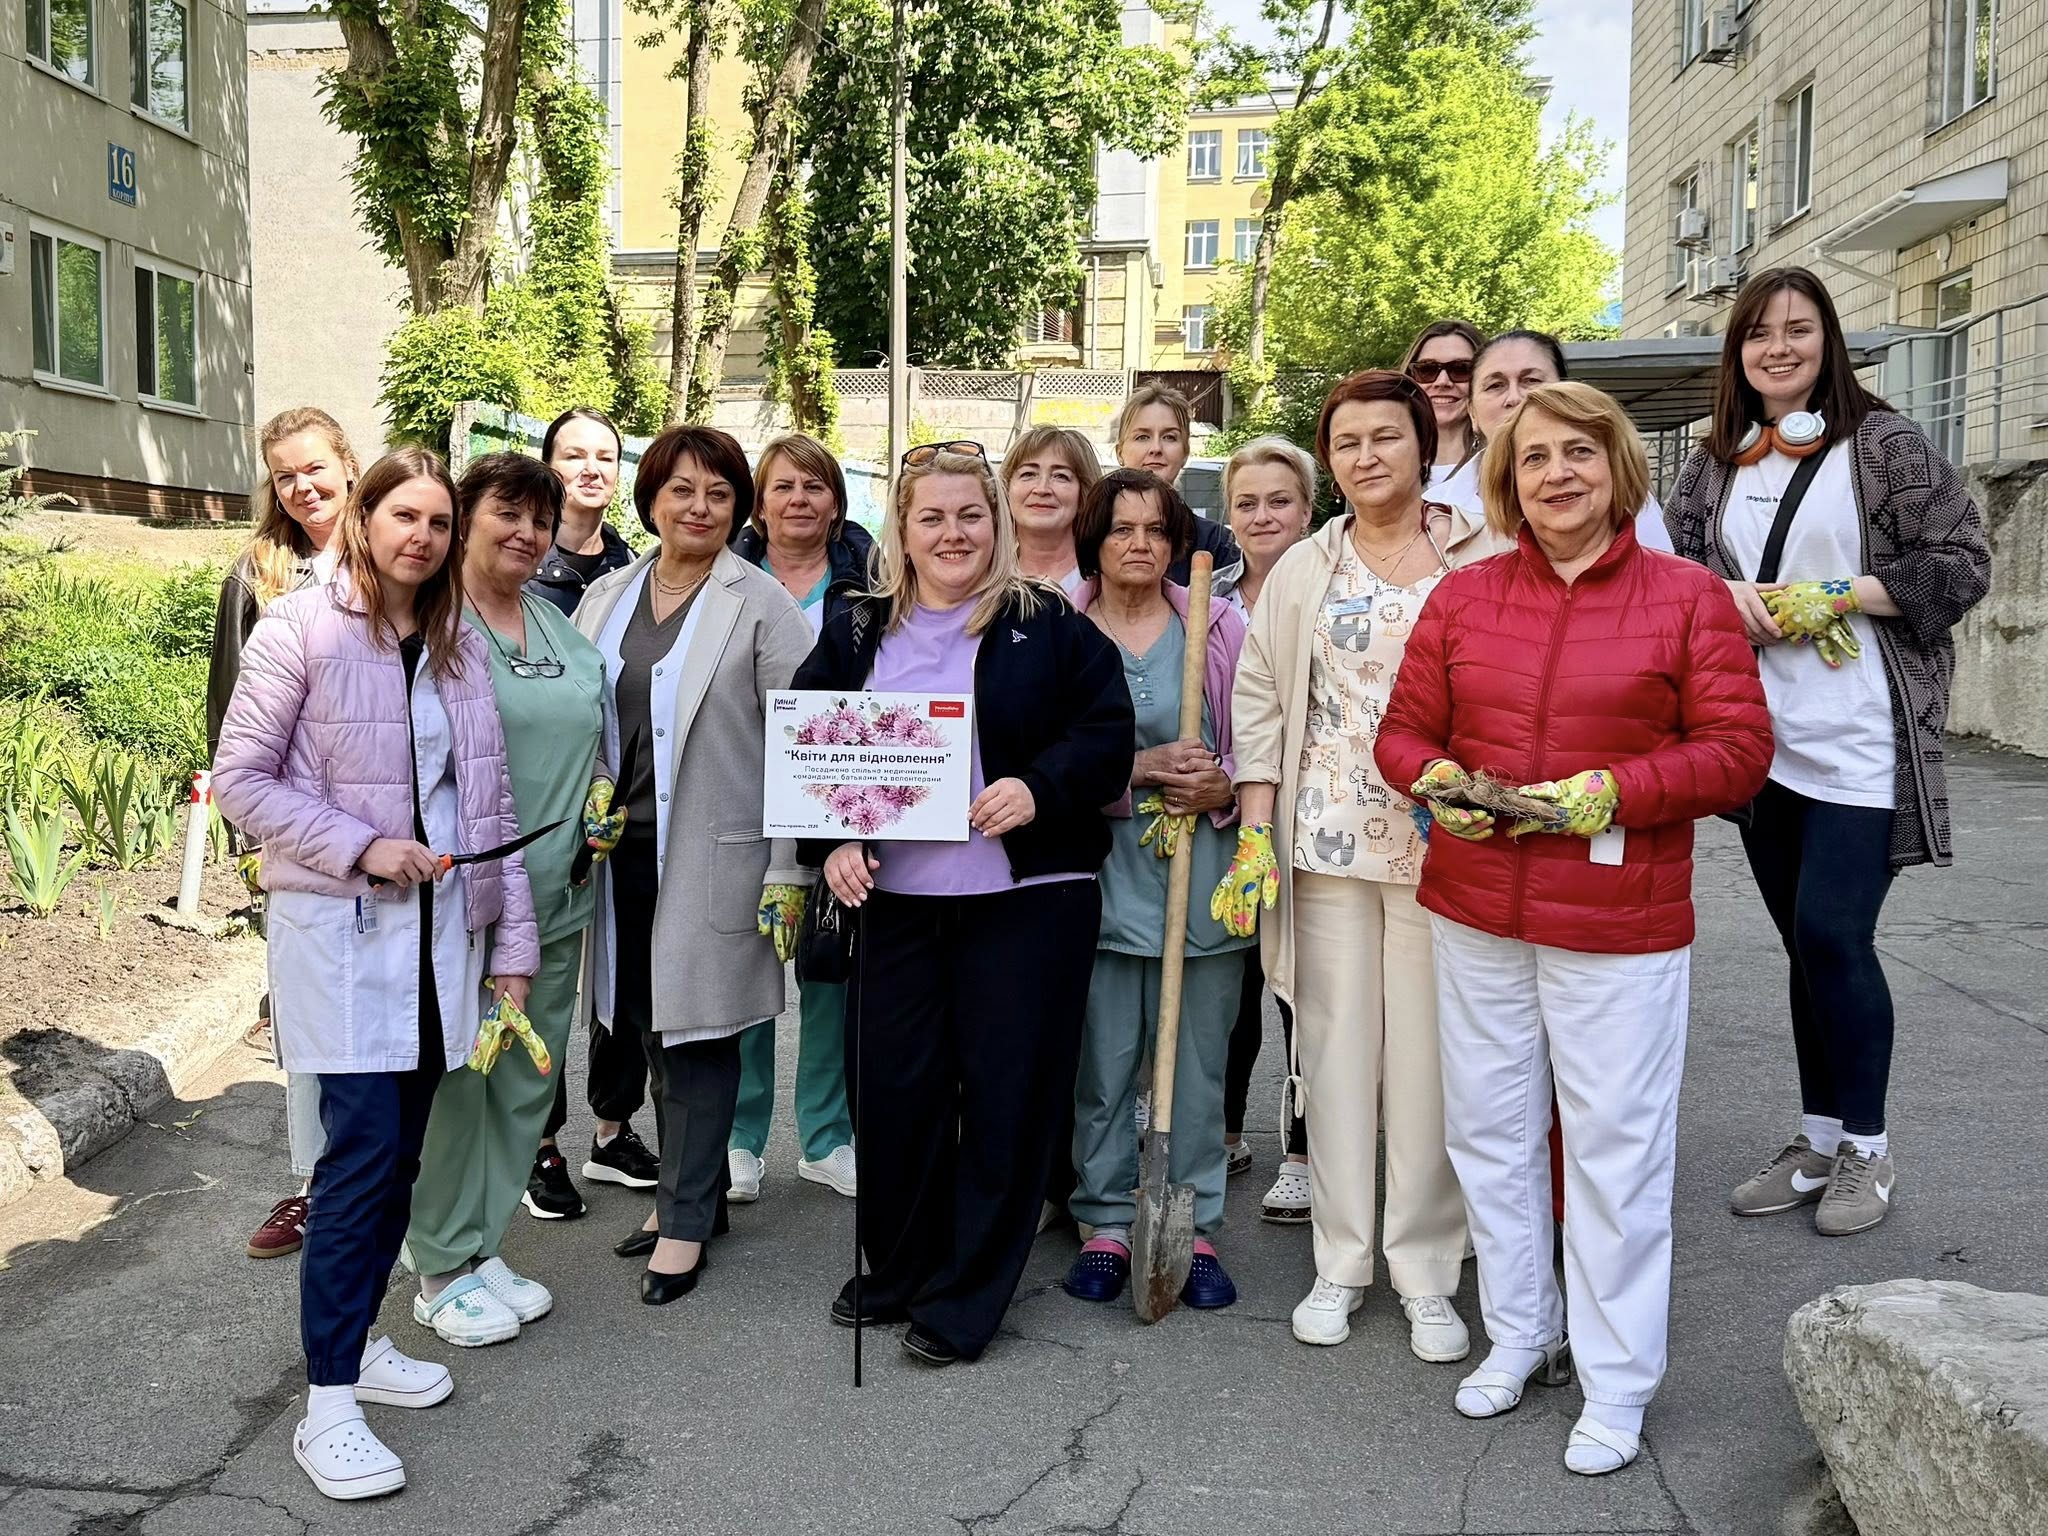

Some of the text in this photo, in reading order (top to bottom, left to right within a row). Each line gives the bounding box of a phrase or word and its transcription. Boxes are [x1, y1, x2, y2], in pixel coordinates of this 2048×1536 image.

[112, 148, 133, 188] 16
[830, 753, 855, 763] для
[804, 765, 849, 774] Посаджено
